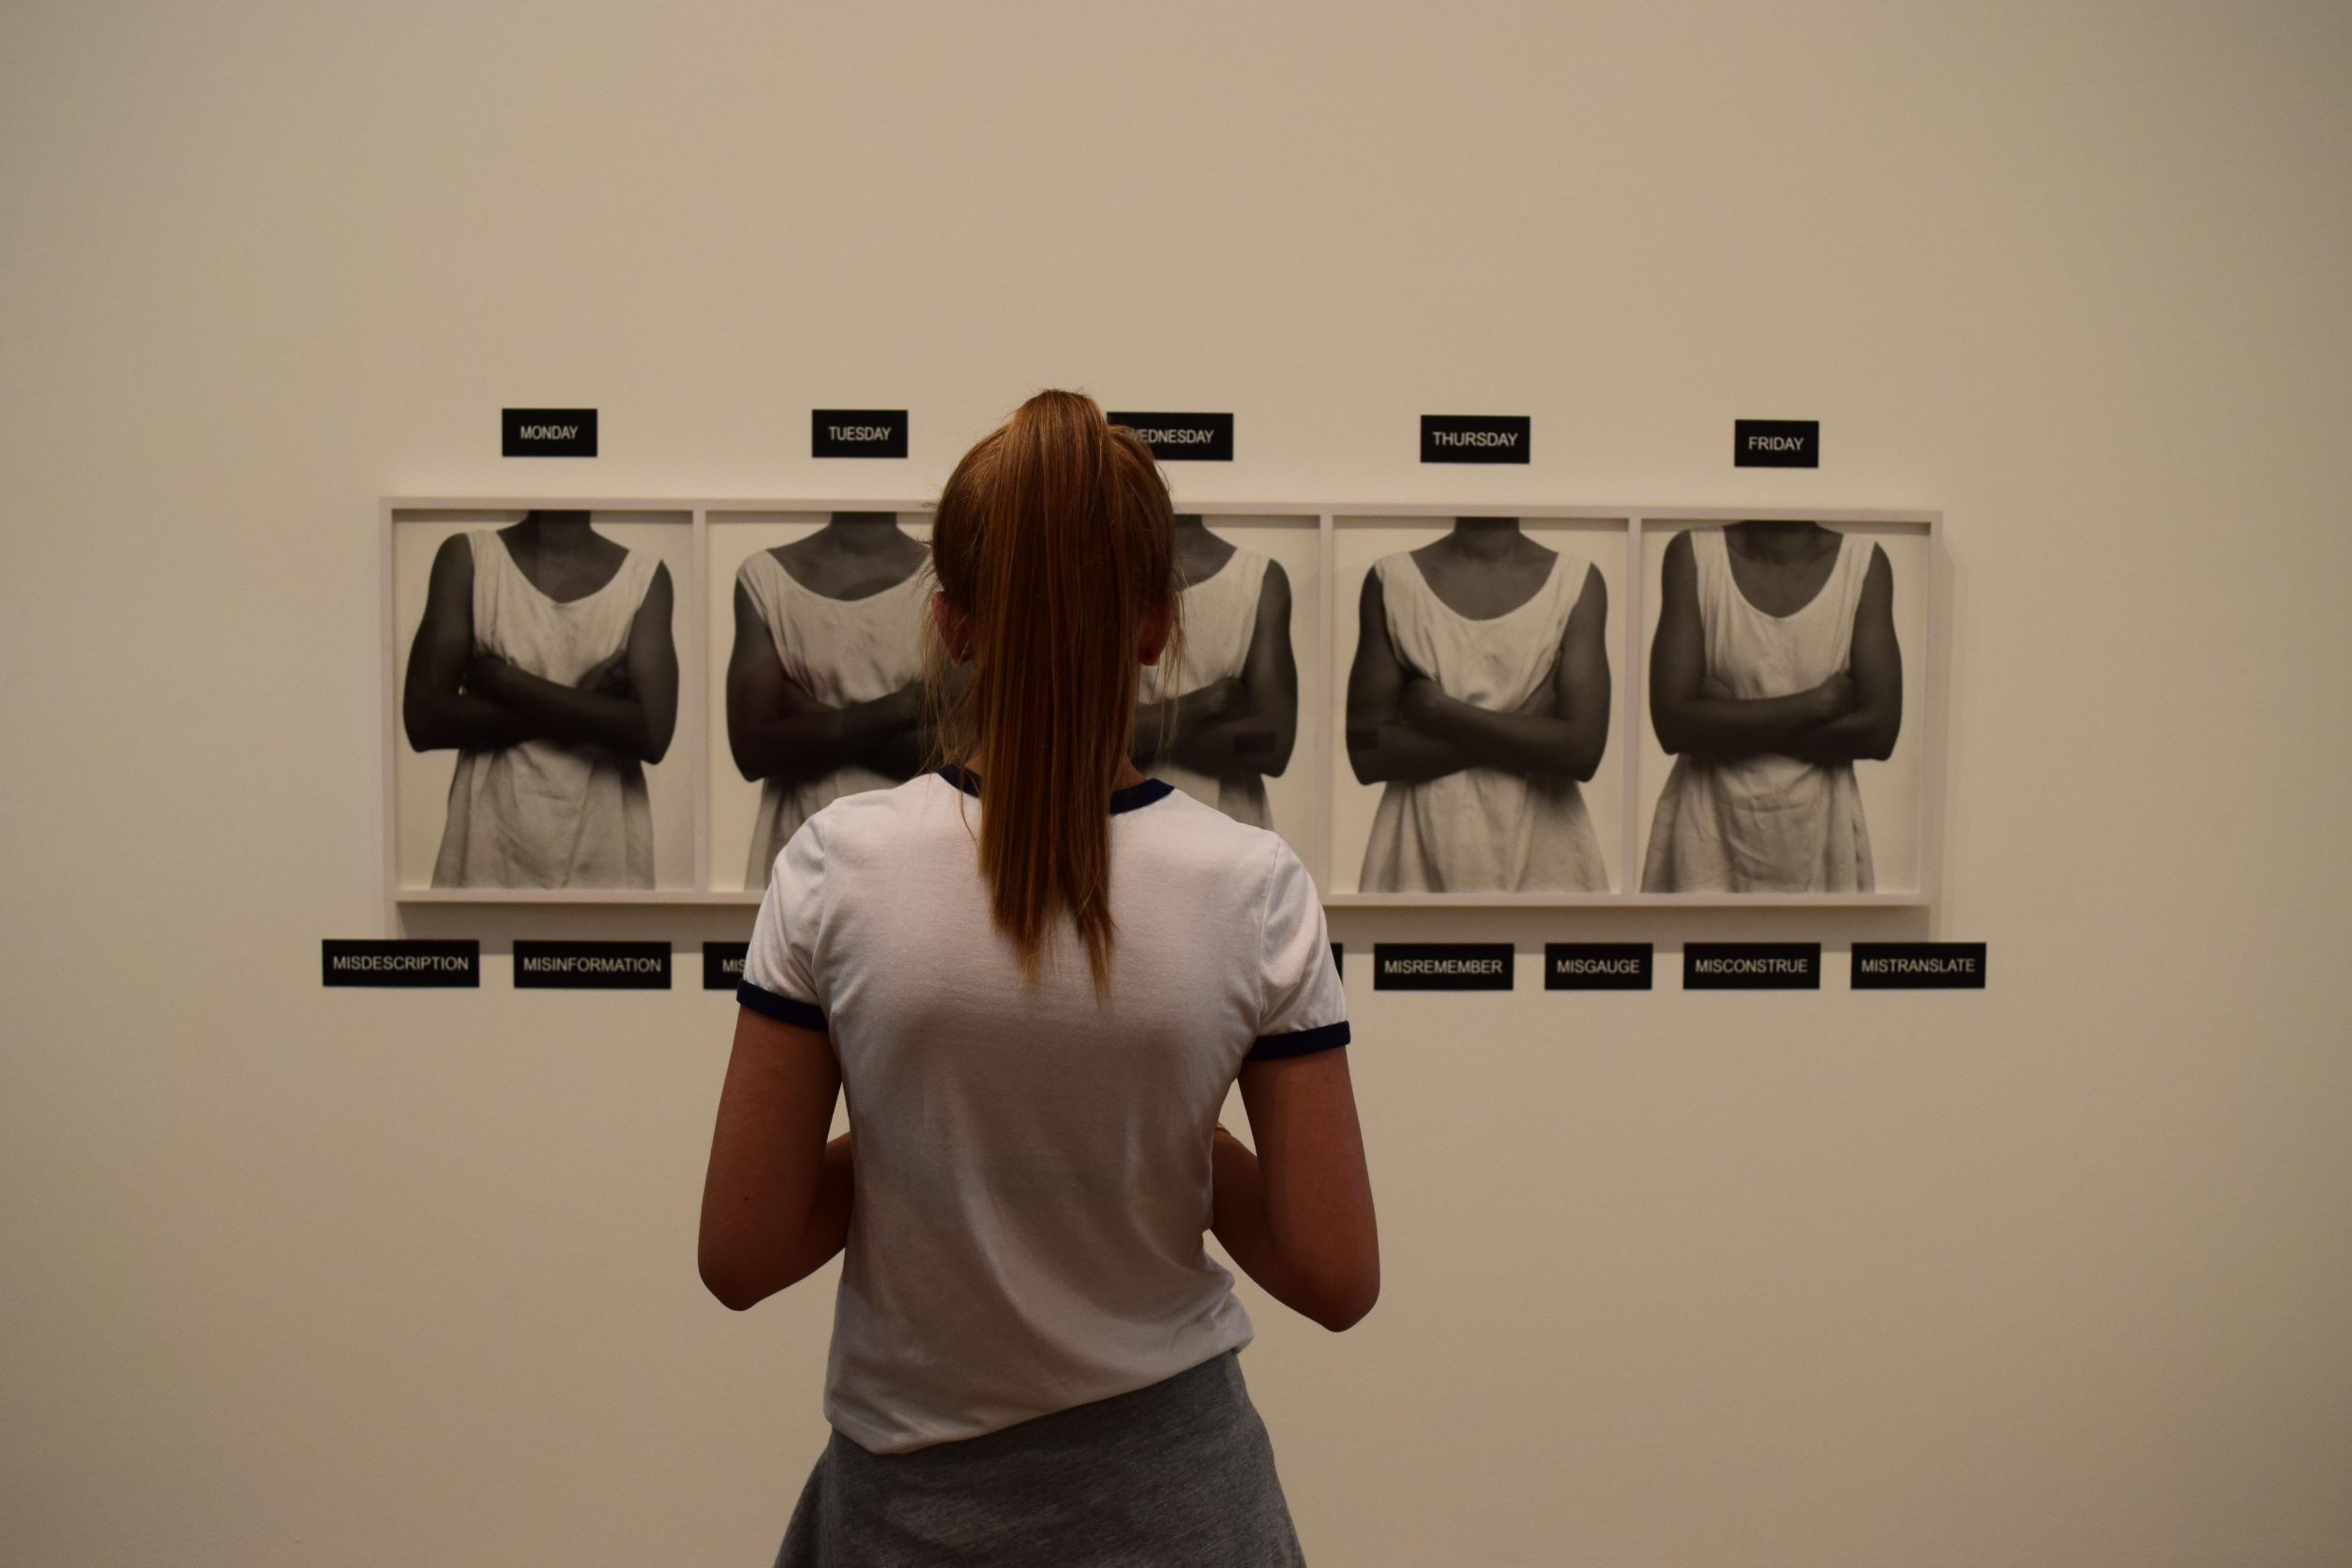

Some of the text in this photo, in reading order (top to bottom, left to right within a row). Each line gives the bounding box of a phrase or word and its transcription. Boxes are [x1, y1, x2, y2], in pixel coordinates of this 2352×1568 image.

[520, 425, 579, 440] MONDAY
[829, 426, 892, 441] TUESDAY
[1432, 431, 1518, 446] THURSDAY
[1748, 436, 1805, 451] FRIDAY
[333, 956, 469, 970] MISDESCRIPTION
[523, 957, 662, 972] MISINFORMATION
[1384, 959, 1503, 974] MISREMEMBER
[1557, 959, 1640, 973] MISGAUGE
[1696, 958, 1808, 973] MISCONSTRUE
[1862, 958, 1976, 972] MISTRANSLATE
